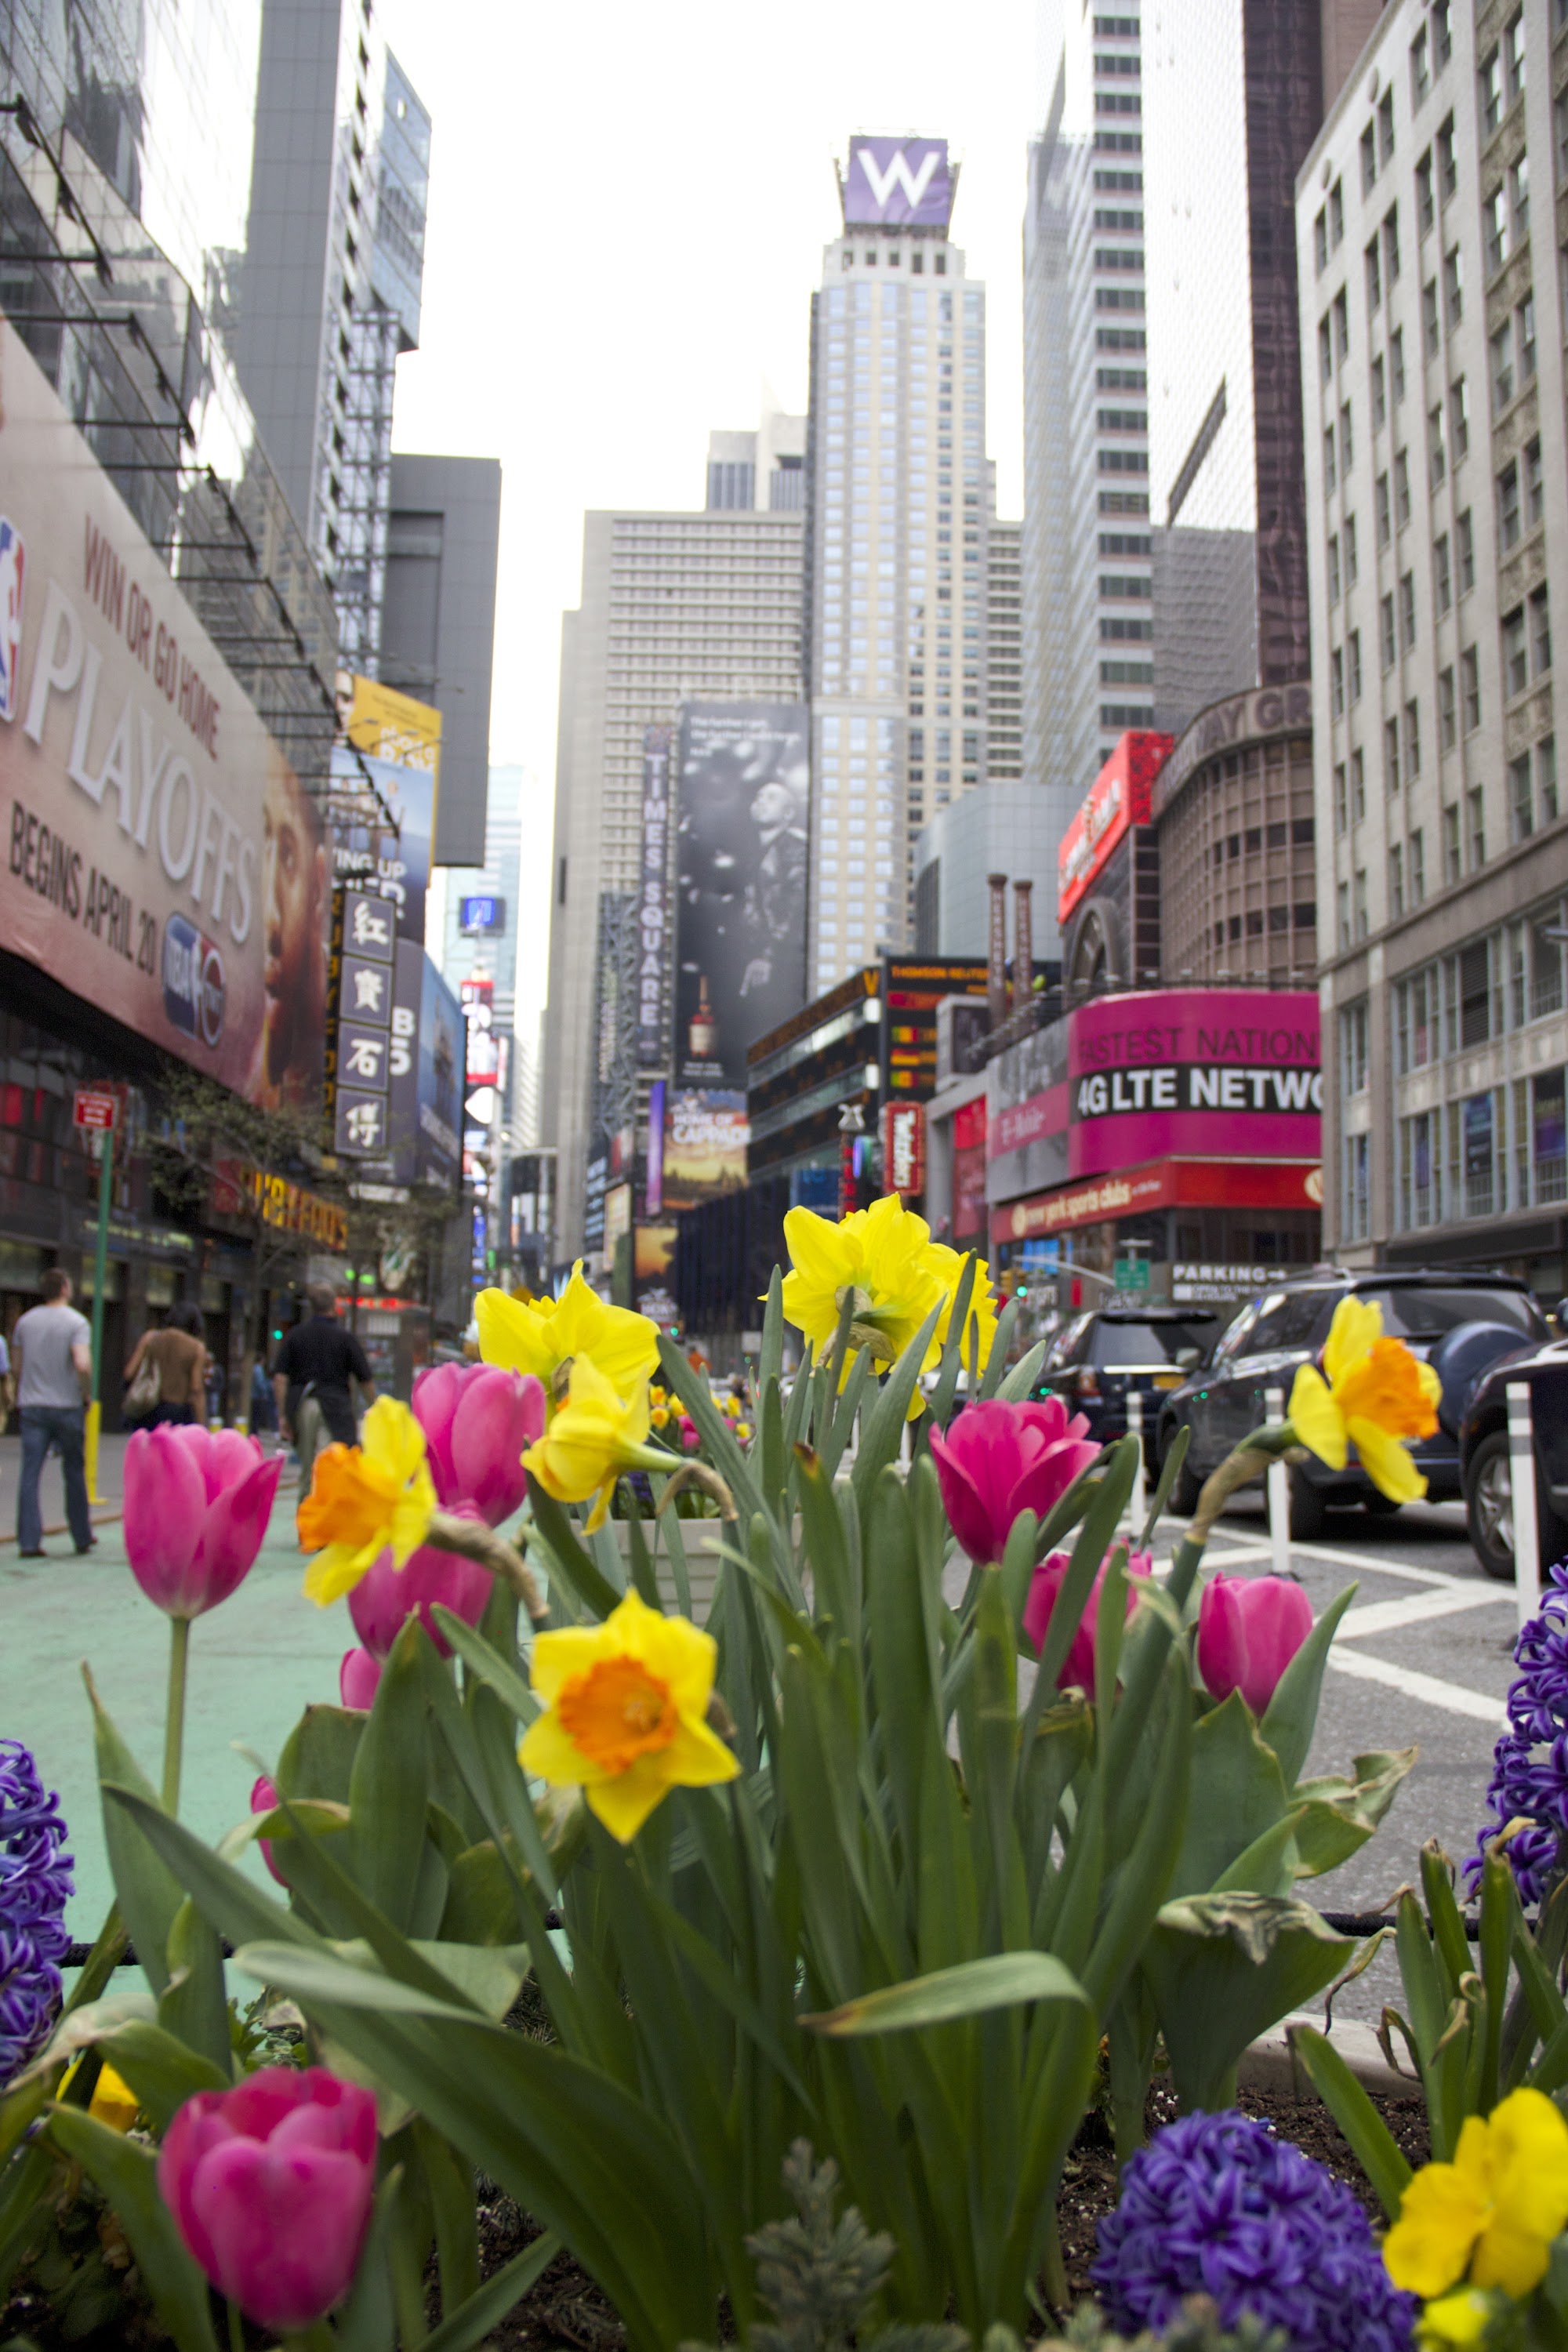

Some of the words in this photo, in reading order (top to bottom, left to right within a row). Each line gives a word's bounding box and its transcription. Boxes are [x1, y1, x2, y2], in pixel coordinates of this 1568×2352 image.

[857, 150, 939, 209] W
[85, 513, 126, 633] WIN
[126, 579, 153, 674] OR
[155, 621, 178, 705] GO
[178, 659, 222, 761] HOME
[23, 577, 256, 946] PLAYOFFS
[643, 753, 668, 870] TIMES
[9, 800, 83, 922] BEGINS
[84, 866, 133, 963] APRIL
[136, 906, 158, 977] 20
[377, 855, 408, 881] UP
[639, 881, 666, 1028] SQUARE
[1078, 1026, 1184, 1065] FASTEST
[673, 1112, 713, 1125] HOME
[714, 1112, 734, 1126] OF
[1076, 1072, 1108, 1116] 4G
[1112, 1067, 1178, 1109] LTE
[1172, 1264, 1268, 1283] PARKING
